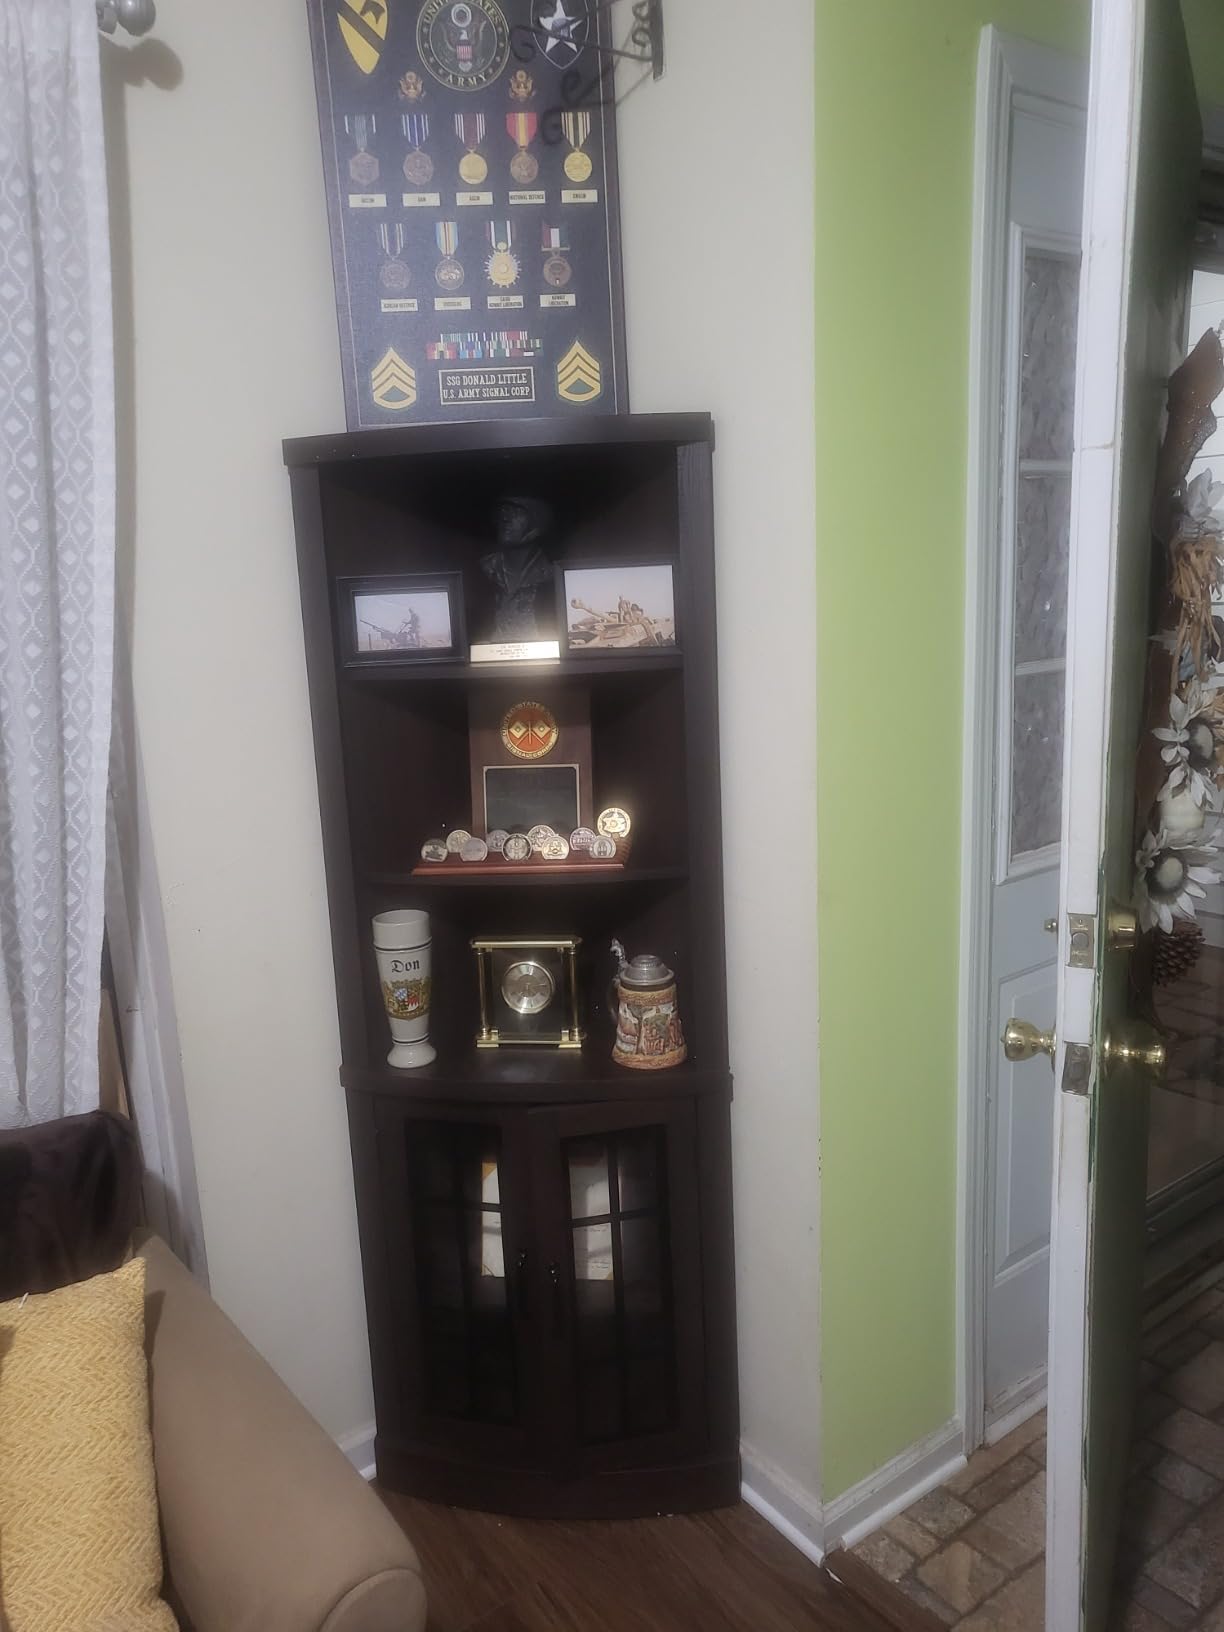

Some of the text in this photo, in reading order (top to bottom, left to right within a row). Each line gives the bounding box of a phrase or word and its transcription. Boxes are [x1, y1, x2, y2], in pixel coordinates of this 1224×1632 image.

[446, 71, 487, 87] ARMY
[446, 373, 528, 386] SSG DONALD LITTLE
[443, 386, 530, 399] U.S. ARMY SIGNAL CORP
[507, 742, 531, 758] SIGNAL
[391, 959, 420, 973] Don
